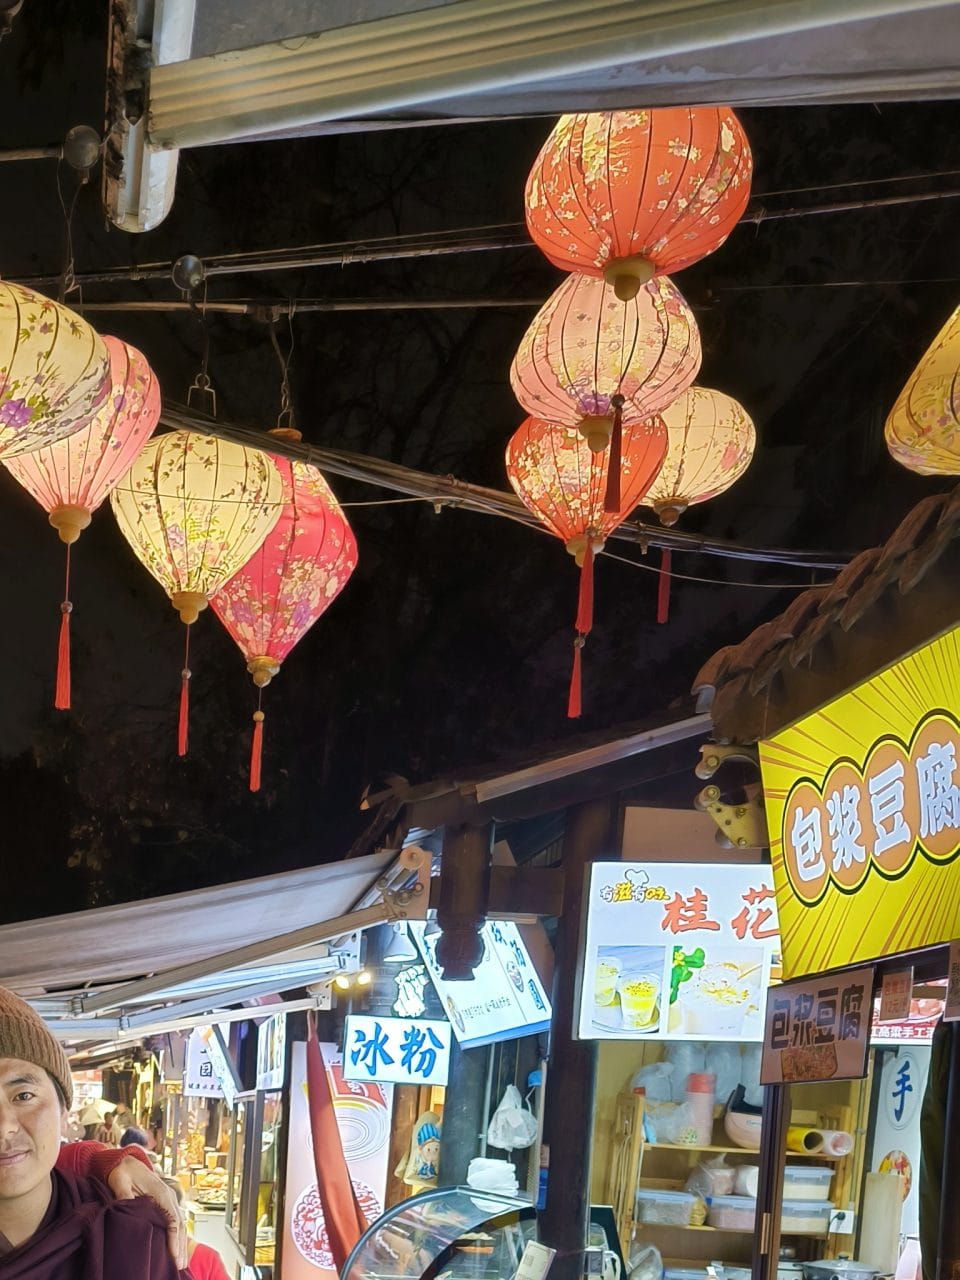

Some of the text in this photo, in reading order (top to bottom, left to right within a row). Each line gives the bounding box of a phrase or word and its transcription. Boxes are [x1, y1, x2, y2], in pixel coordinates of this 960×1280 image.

[792, 741, 960, 882] 包浆豆腐
[661, 884, 780, 940] 桂花
[771, 984, 864, 1050] 包浆豆腐
[351, 1022, 445, 1078] 冰粉
[892, 1060, 913, 1122] 手
